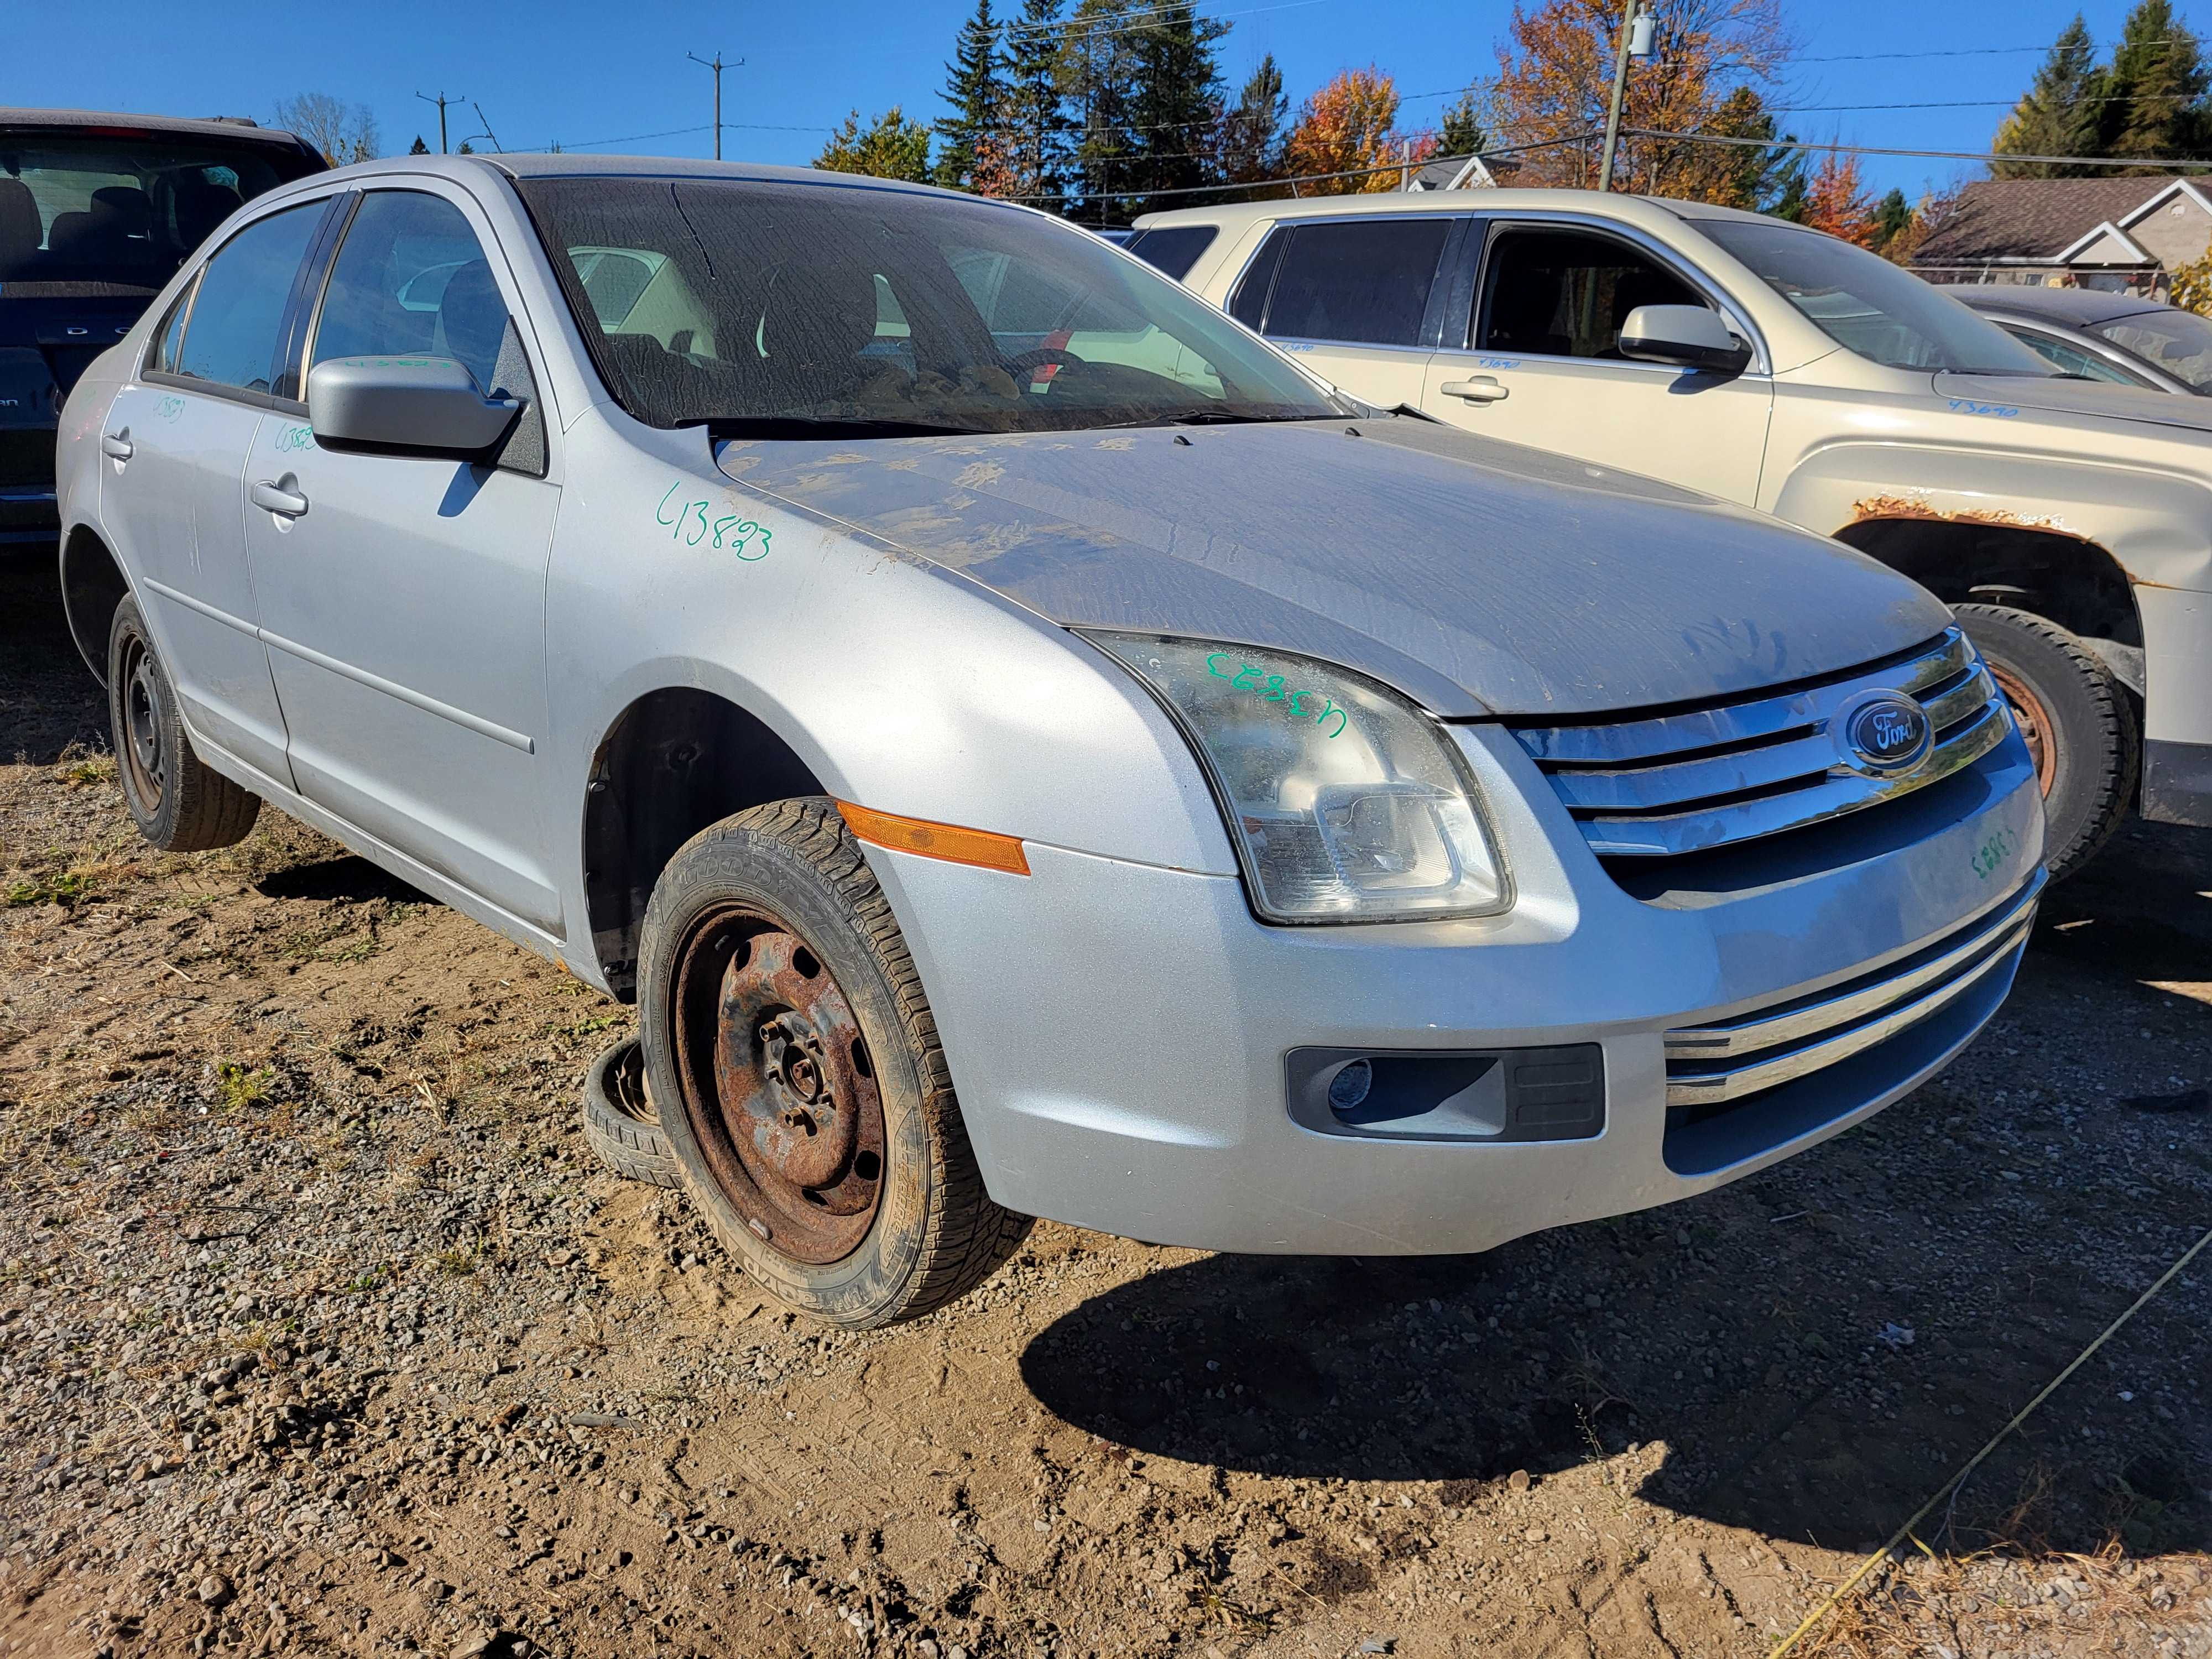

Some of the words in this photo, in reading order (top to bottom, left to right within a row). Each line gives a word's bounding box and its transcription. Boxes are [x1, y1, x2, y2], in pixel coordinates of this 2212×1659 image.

[1949, 400, 2018, 417] 43690
[656, 481, 773, 561] 43823
[1207, 653, 1348, 739] 43823
[1872, 711, 1917, 750] Ford
[677, 856, 889, 1048] GOODYEAR
